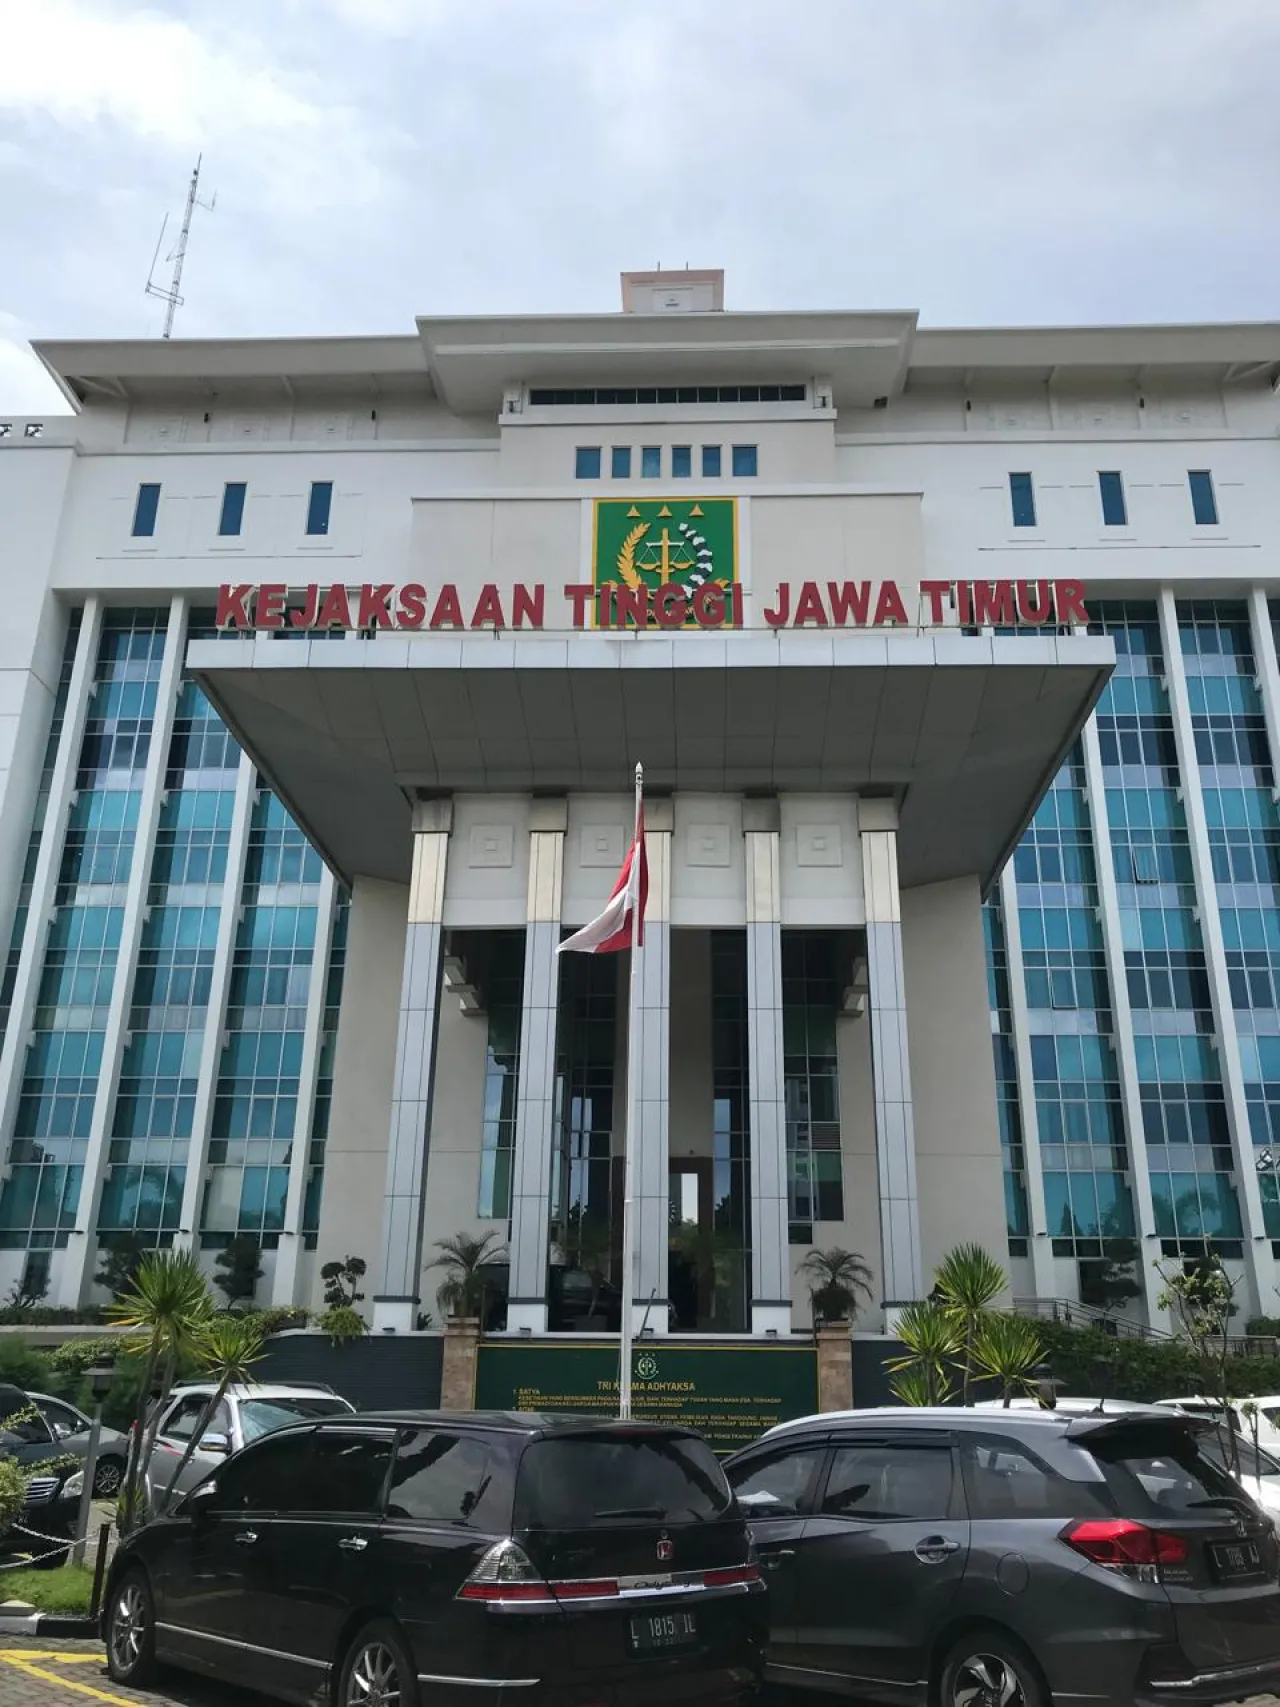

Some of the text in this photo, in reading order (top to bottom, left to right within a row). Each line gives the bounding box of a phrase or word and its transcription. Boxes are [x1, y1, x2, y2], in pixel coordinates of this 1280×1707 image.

[216, 578, 1089, 630] KEJAKSAAN TINGGI JAWA TIMUR
[597, 1381, 696, 1392] TRI KMA ADHYAKSA
[630, 1620, 639, 1639] L
[649, 1616, 675, 1637] 1815
